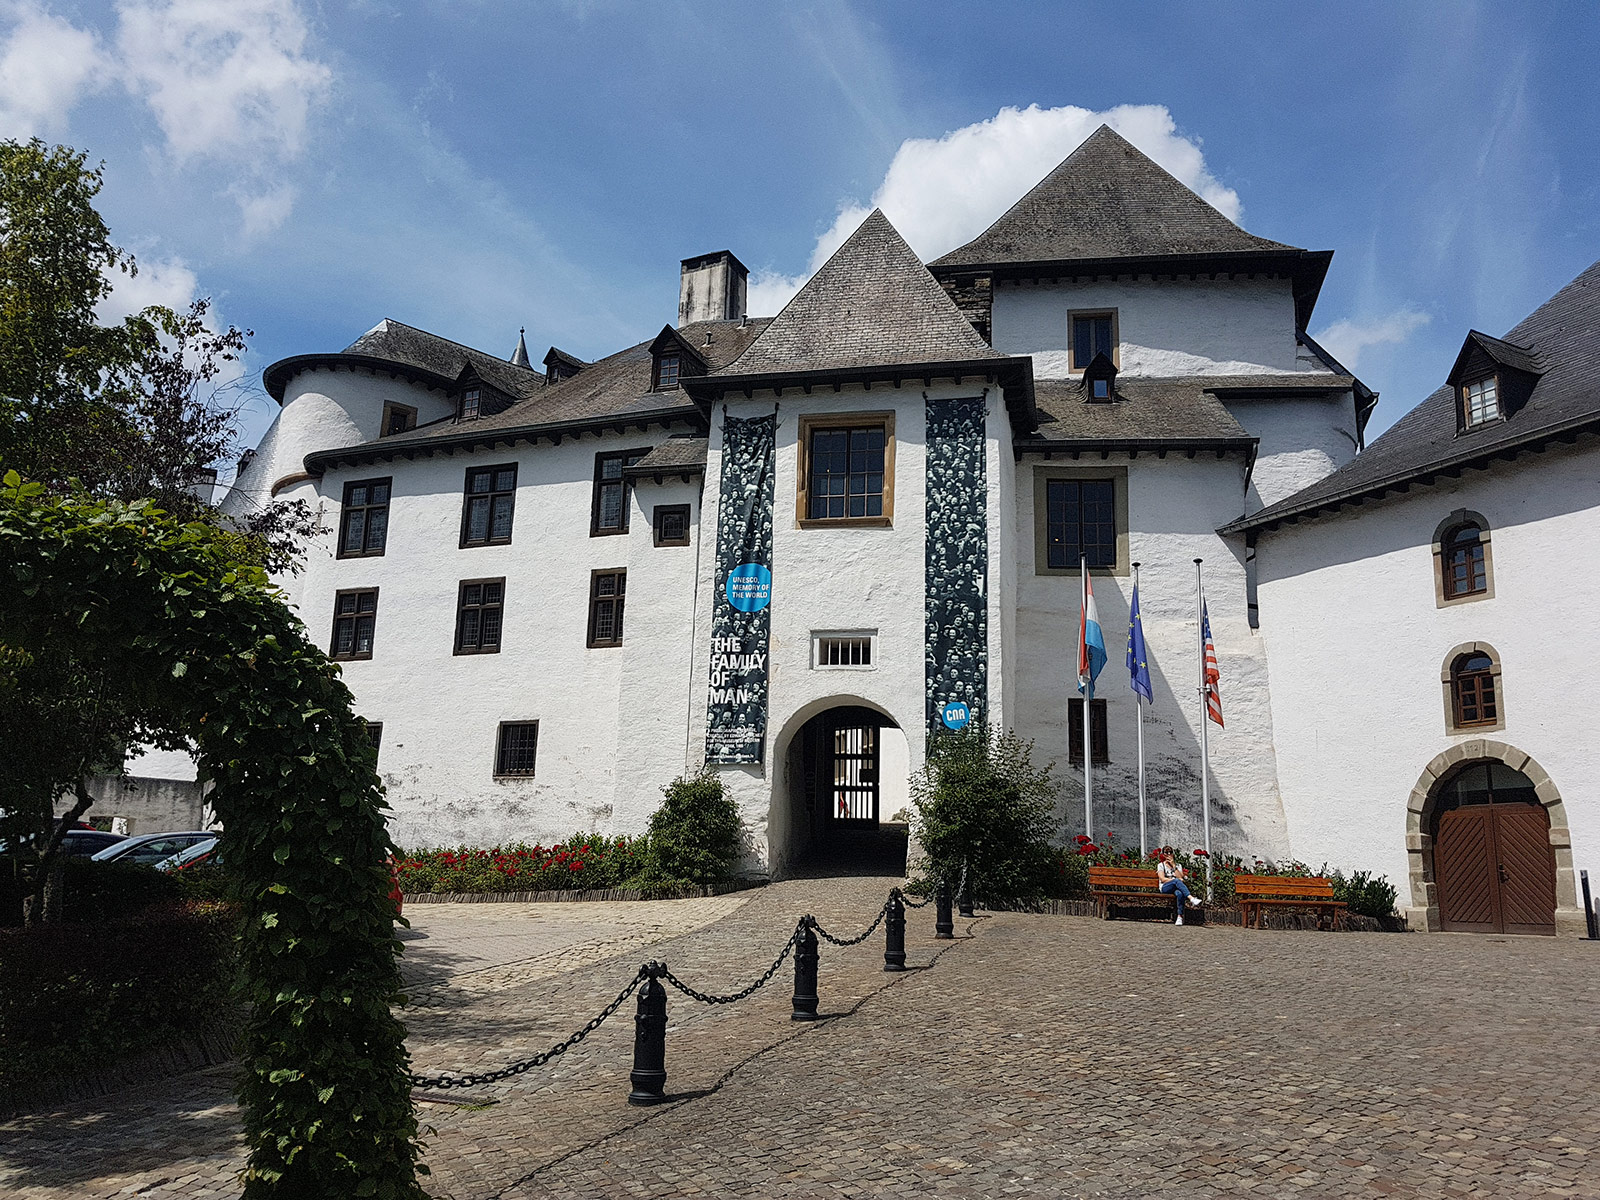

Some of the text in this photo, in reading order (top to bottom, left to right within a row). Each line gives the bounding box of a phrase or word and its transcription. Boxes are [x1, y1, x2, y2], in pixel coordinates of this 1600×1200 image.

[711, 637, 741, 652] THE
[711, 654, 767, 669] FAMILY
[711, 671, 730, 687] OF
[710, 688, 748, 704] MAN
[946, 708, 965, 721] CNA
